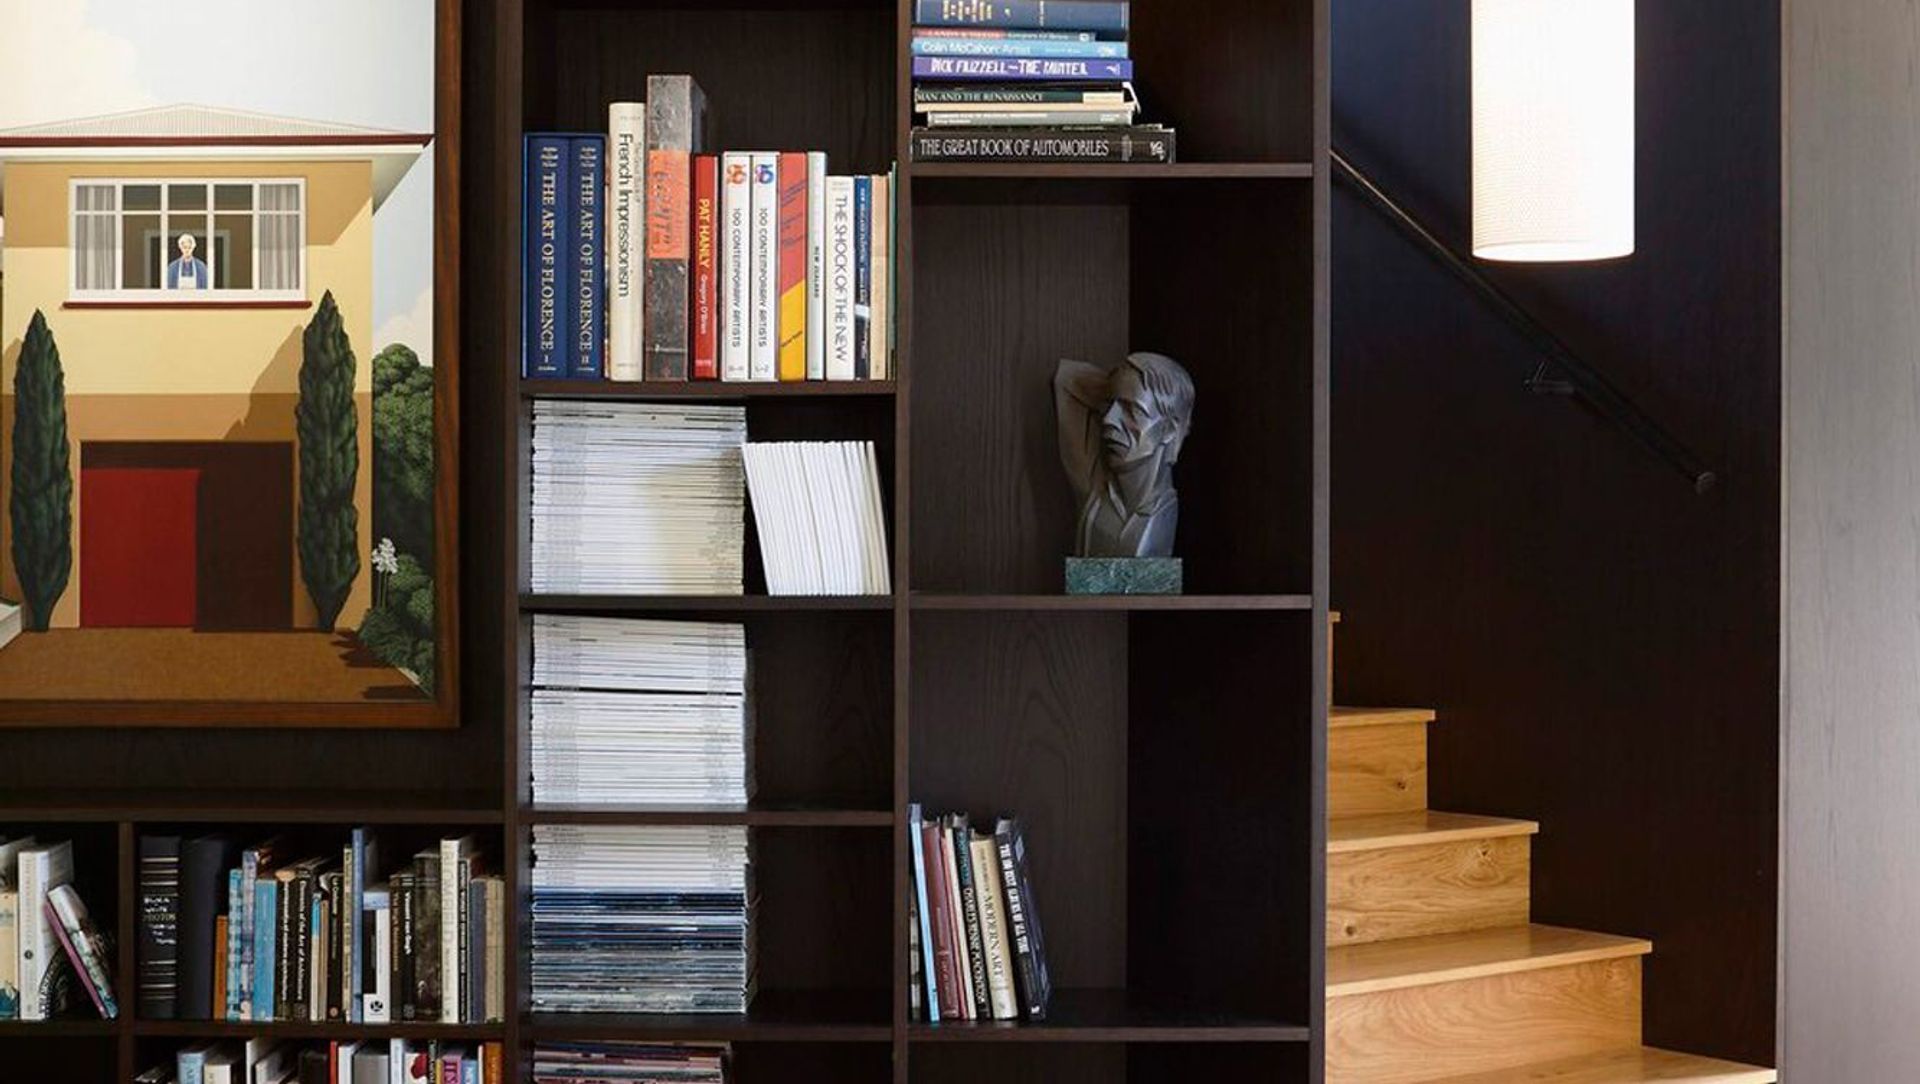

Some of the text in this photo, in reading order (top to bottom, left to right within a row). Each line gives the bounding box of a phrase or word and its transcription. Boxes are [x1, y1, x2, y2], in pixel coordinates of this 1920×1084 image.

[938, 92, 959, 102] AND
[920, 139, 1109, 157] THE GREAT BOOK OF AUTOMOBILES
[541, 172, 556, 205] THE
[580, 172, 595, 205] THE
[541, 209, 556, 240] ART
[580, 209, 595, 240] ART
[615, 133, 635, 297] French Impressionism
[541, 243, 556, 265] OF
[580, 243, 595, 265] OF
[698, 198, 711, 335] PAT HANLY Gregory O'Brien
[732, 227, 741, 305] CONTEMPORARY
[758, 227, 768, 305] CONTEMPORARY
[834, 196, 848, 362] THE SHOCK OF THE NEW
[541, 268, 556, 351] FLORENCE
[580, 269, 595, 352] FLORENCE
[732, 309, 741, 348] ARTISTS
[758, 309, 768, 348] ARTISTS
[404, 892, 412, 954] Vincent van Gogh
[983, 895, 1004, 977] MODERN ART
